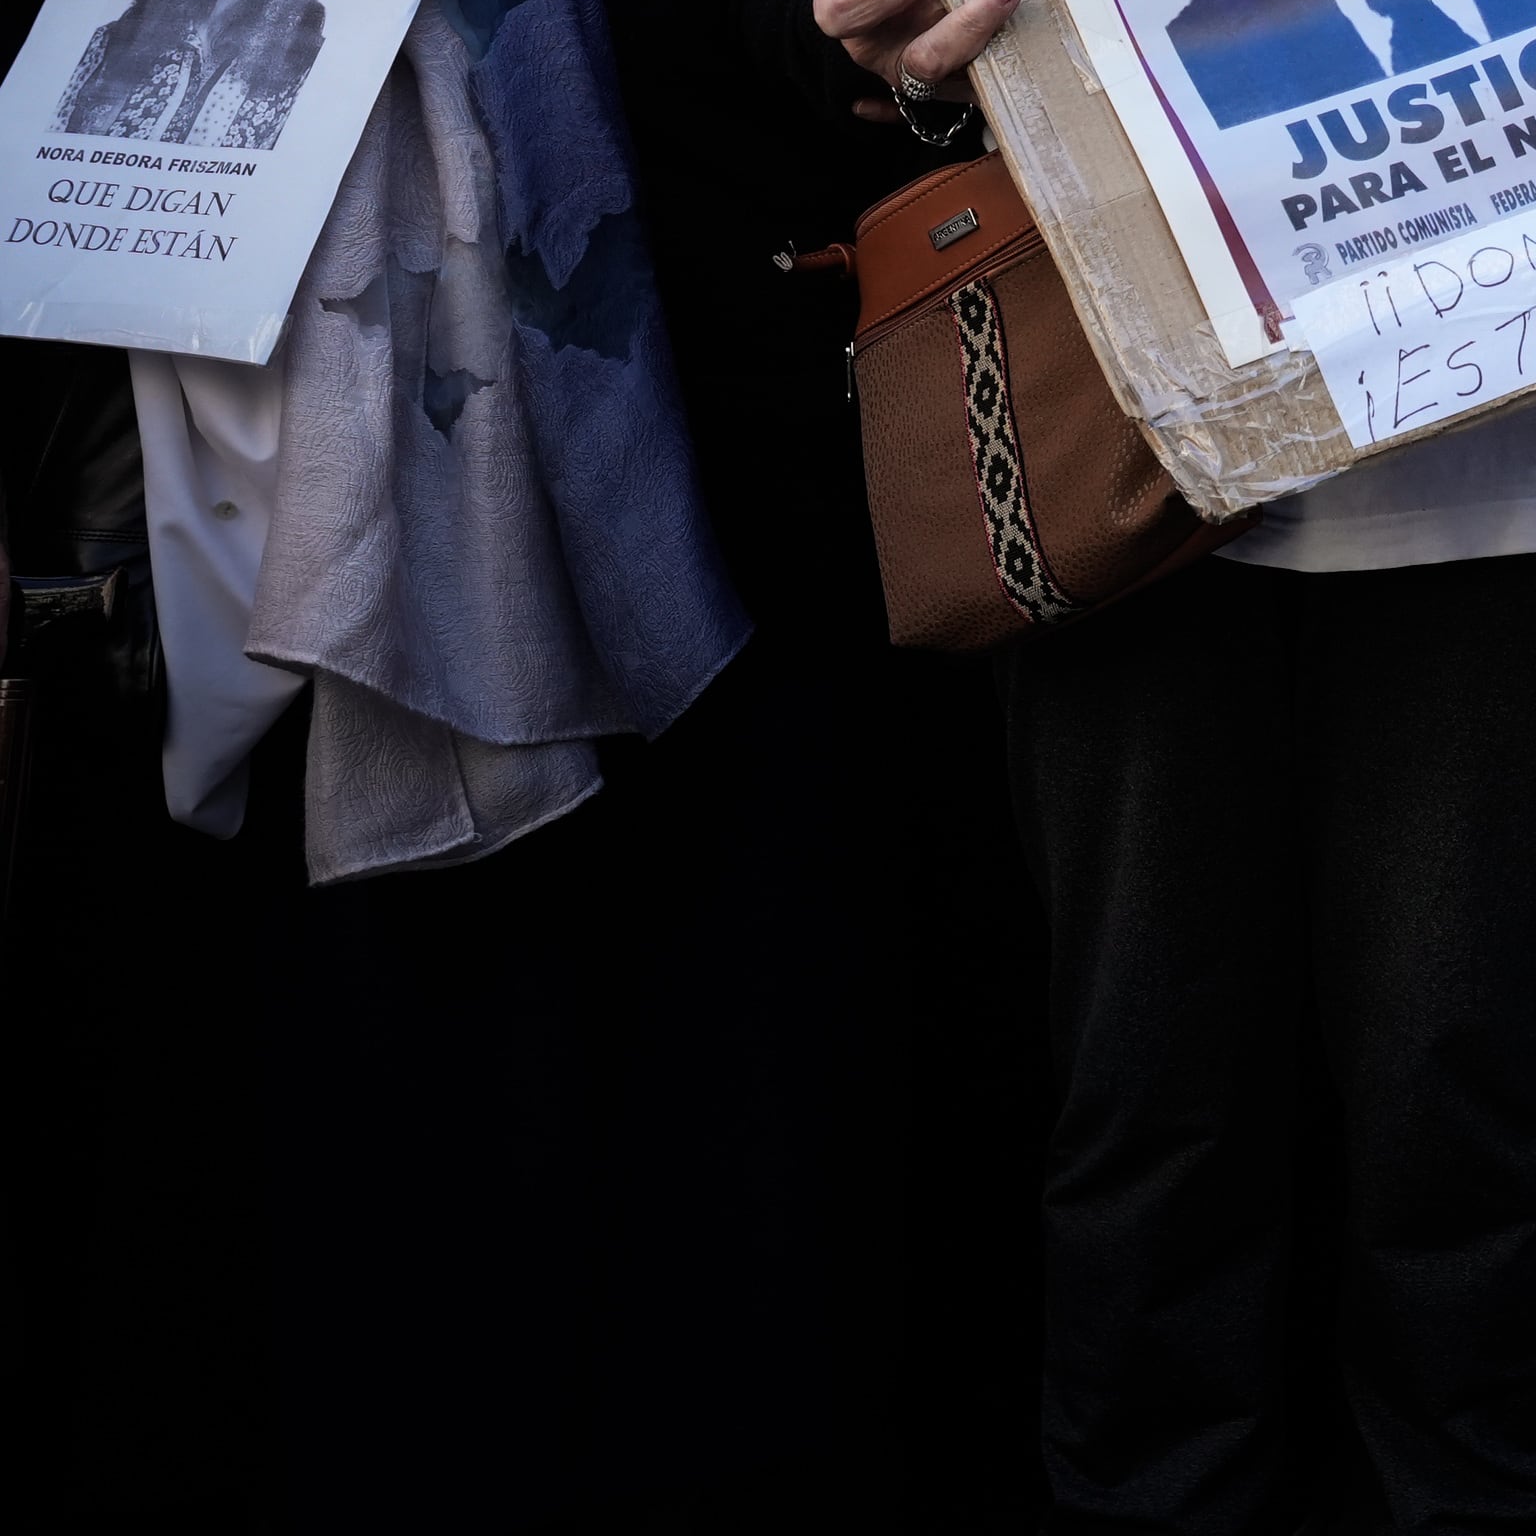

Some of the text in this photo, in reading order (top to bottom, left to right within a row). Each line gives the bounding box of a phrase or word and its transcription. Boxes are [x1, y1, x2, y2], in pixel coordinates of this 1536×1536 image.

[36, 146, 257, 177] NORA DEBORA FRISZMAN
[48, 179, 237, 218] QUE DIGAN
[1280, 161, 1428, 232] PARA
[1433, 139, 1496, 184] EL
[5, 218, 239, 263] DONDE ESTÁN
[1335, 226, 1398, 266] PARTIDO
[1399, 202, 1478, 245] COMUNISTA
